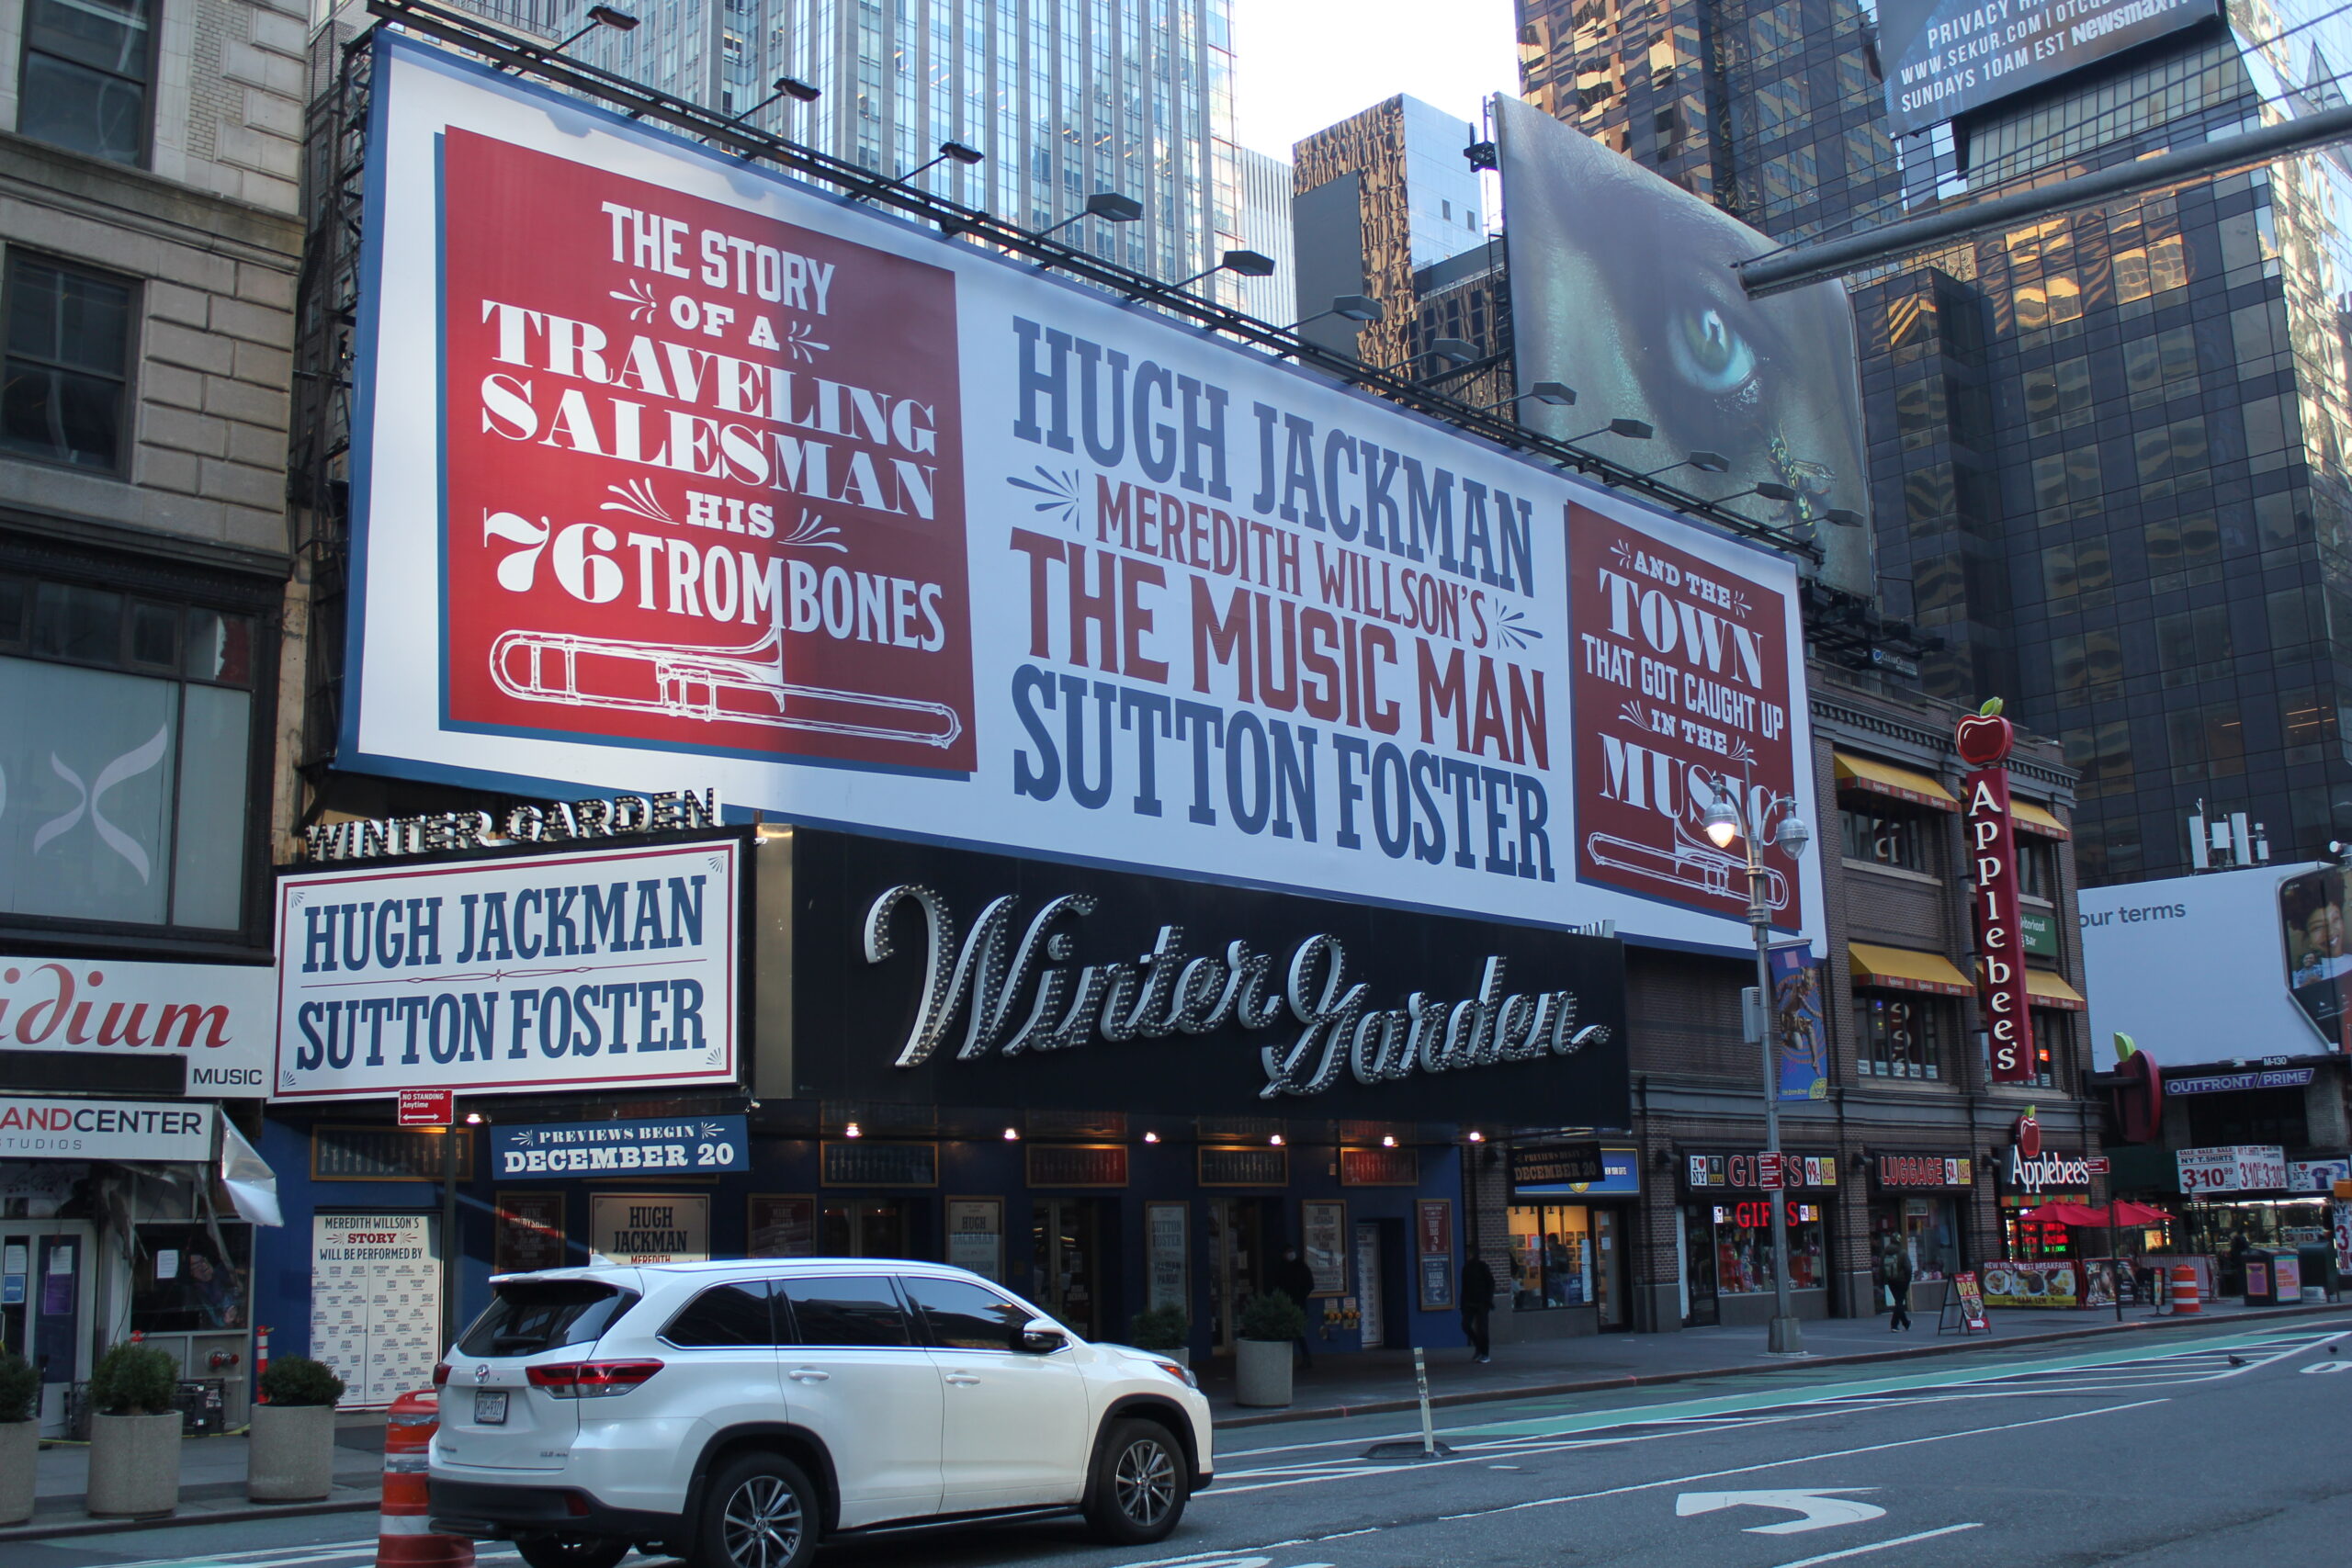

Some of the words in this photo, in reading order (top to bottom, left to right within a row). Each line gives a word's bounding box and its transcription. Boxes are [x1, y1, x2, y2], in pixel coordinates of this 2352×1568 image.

[1928, 2, 2009, 49] PRIVACY
[1901, 14, 2041, 85] WWW.SEKUR.COM
[1901, 69, 1975, 112] SUNDAYS
[1983, 47, 2030, 82] 10AM
[2034, 32, 2065, 61] EST
[602, 200, 691, 280] THE
[701, 228, 836, 316] STORY
[669, 294, 735, 338] OF
[748, 316, 780, 351] A
[481, 299, 937, 457] TRAVELING
[481, 373, 937, 521] SALESMAN
[1012, 316, 1232, 502] HUGH
[1252, 400, 1534, 598] JACKMAN
[685, 491, 775, 538] HIS
[483, 506, 624, 604] 76
[627, 532, 945, 652] TROMBONES
[1095, 473, 1301, 596] MEREDITH
[1314, 540, 1488, 649] WILLSON'S
[1634, 551, 1680, 587] AND
[1685, 572, 1731, 606] THE
[1010, 526, 1170, 684] THE
[1189, 574, 1400, 735] MUSIC
[1415, 637, 1551, 771] MAN
[1599, 567, 1764, 690] TOWN
[1581, 633, 1634, 689] THAT
[1641, 656, 1679, 697] GOT
[1684, 673, 1756, 731] CAUGHT
[1760, 701, 1783, 741] UP
[1651, 708, 1676, 738] IN
[1682, 723, 1727, 755] THE
[1011, 664, 1317, 842] SUTTON
[1332, 733, 1555, 882] FOSTER
[1598, 733, 1779, 847] MUSIC
[305, 809, 492, 861] WINTER
[505, 787, 724, 841] GARDEN
[301, 897, 443, 973] HUGH
[456, 874, 707, 964] JACKMAN
[1969, 780, 2017, 1072] Applebee's
[2119, 903, 2186, 923] terms
[864, 883, 1280, 1068] Winter
[1259, 932, 1612, 1100] Garden
[296, 991, 499, 1071] SUTTON
[507, 977, 707, 1060] FOSTER
[193, 1068, 262, 1085] MUSIC
[2170, 1074, 2253, 1093] OUTFRONT
[2264, 1071, 2311, 1087] PRIME
[2264, 1056, 2287, 1066] M-130
[402, 1101, 429, 1110] Anytime
[538, 1128, 634, 1145] PREVIEWS
[639, 1124, 695, 1141] BEGIN
[504, 1145, 689, 1174] DECEMBER
[697, 1143, 734, 1166] 20
[1515, 1163, 1580, 1181] DECEMBER
[1582, 1161, 1596, 1176] 20
[1692, 1171, 1705, 1184] NY
[1728, 1155, 1804, 1187] GIS
[1823, 1161, 1835, 1179] SALE
[1881, 1156, 1944, 1186] LUGGAGE
[2011, 1145, 2089, 1193] Applebee's
[325, 1217, 370, 1229] MEREDITH
[374, 1217, 419, 1228] WILLSON'S
[629, 1206, 673, 1229] HUGH
[962, 1216, 986, 1229] HUGH
[1736, 1201, 1799, 1228] GIFS
[320, 1248, 342, 1260] WILL
[345, 1248, 355, 1260] BE
[357, 1247, 410, 1259] PERFORMED
[412, 1247, 423, 1259] BY
[347, 1233, 397, 1244] STORY
[613, 1230, 687, 1254] JACKMAN
[630, 1255, 671, 1264] MEREDITH
[1958, 1280, 1980, 1296] OPEN
[2019, 1262, 2033, 1270] BEST
[2035, 1261, 2073, 1269] BREAKFAST!
